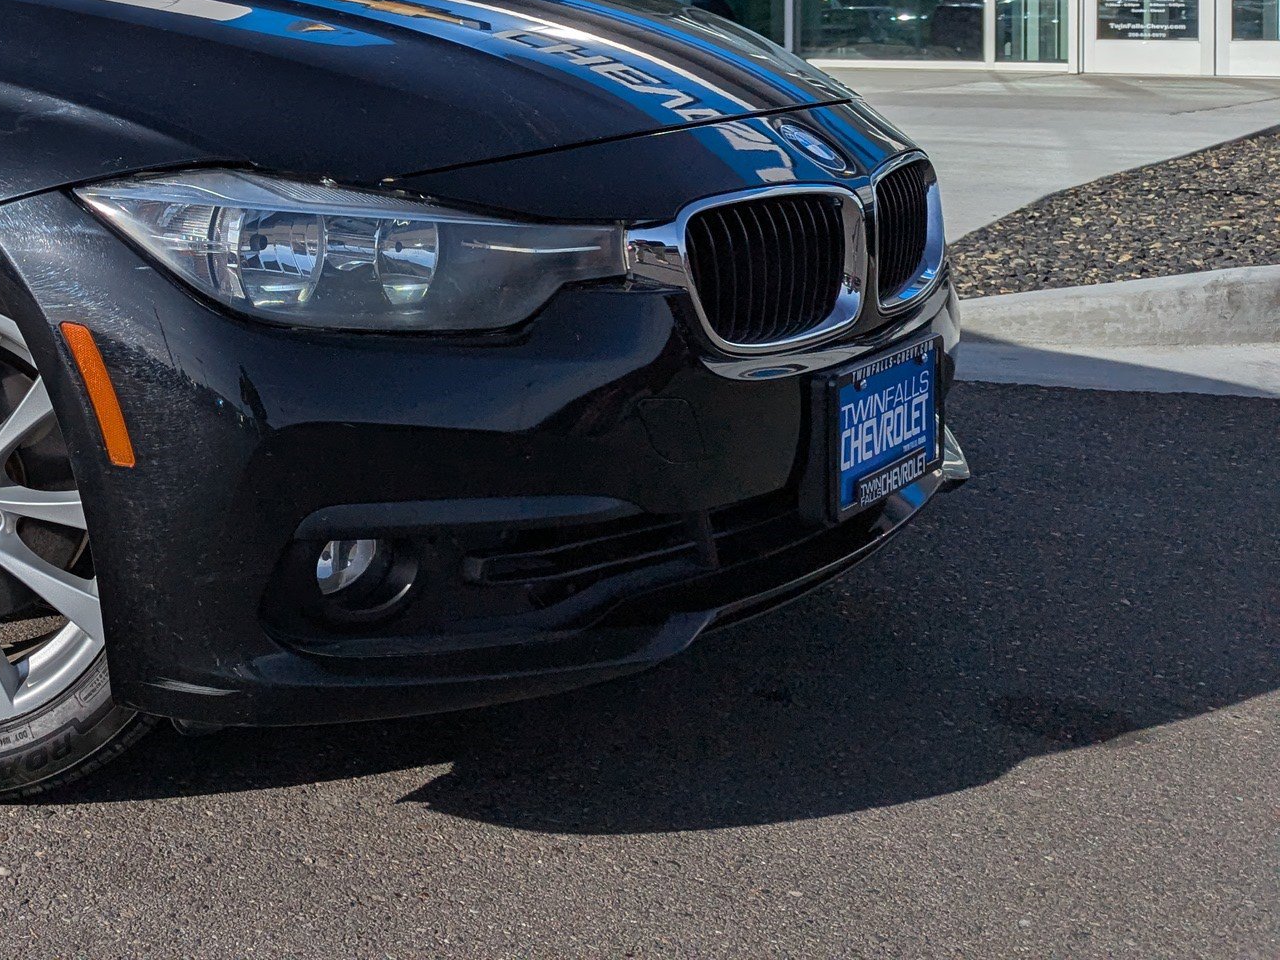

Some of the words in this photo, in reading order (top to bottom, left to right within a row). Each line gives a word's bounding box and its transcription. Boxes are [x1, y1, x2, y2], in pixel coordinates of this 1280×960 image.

[841, 392, 929, 471] CHEVROLET
[861, 476, 881, 496] TWIN
[881, 452, 927, 496] CHEVROLET
[861, 488, 882, 507] FALLS
